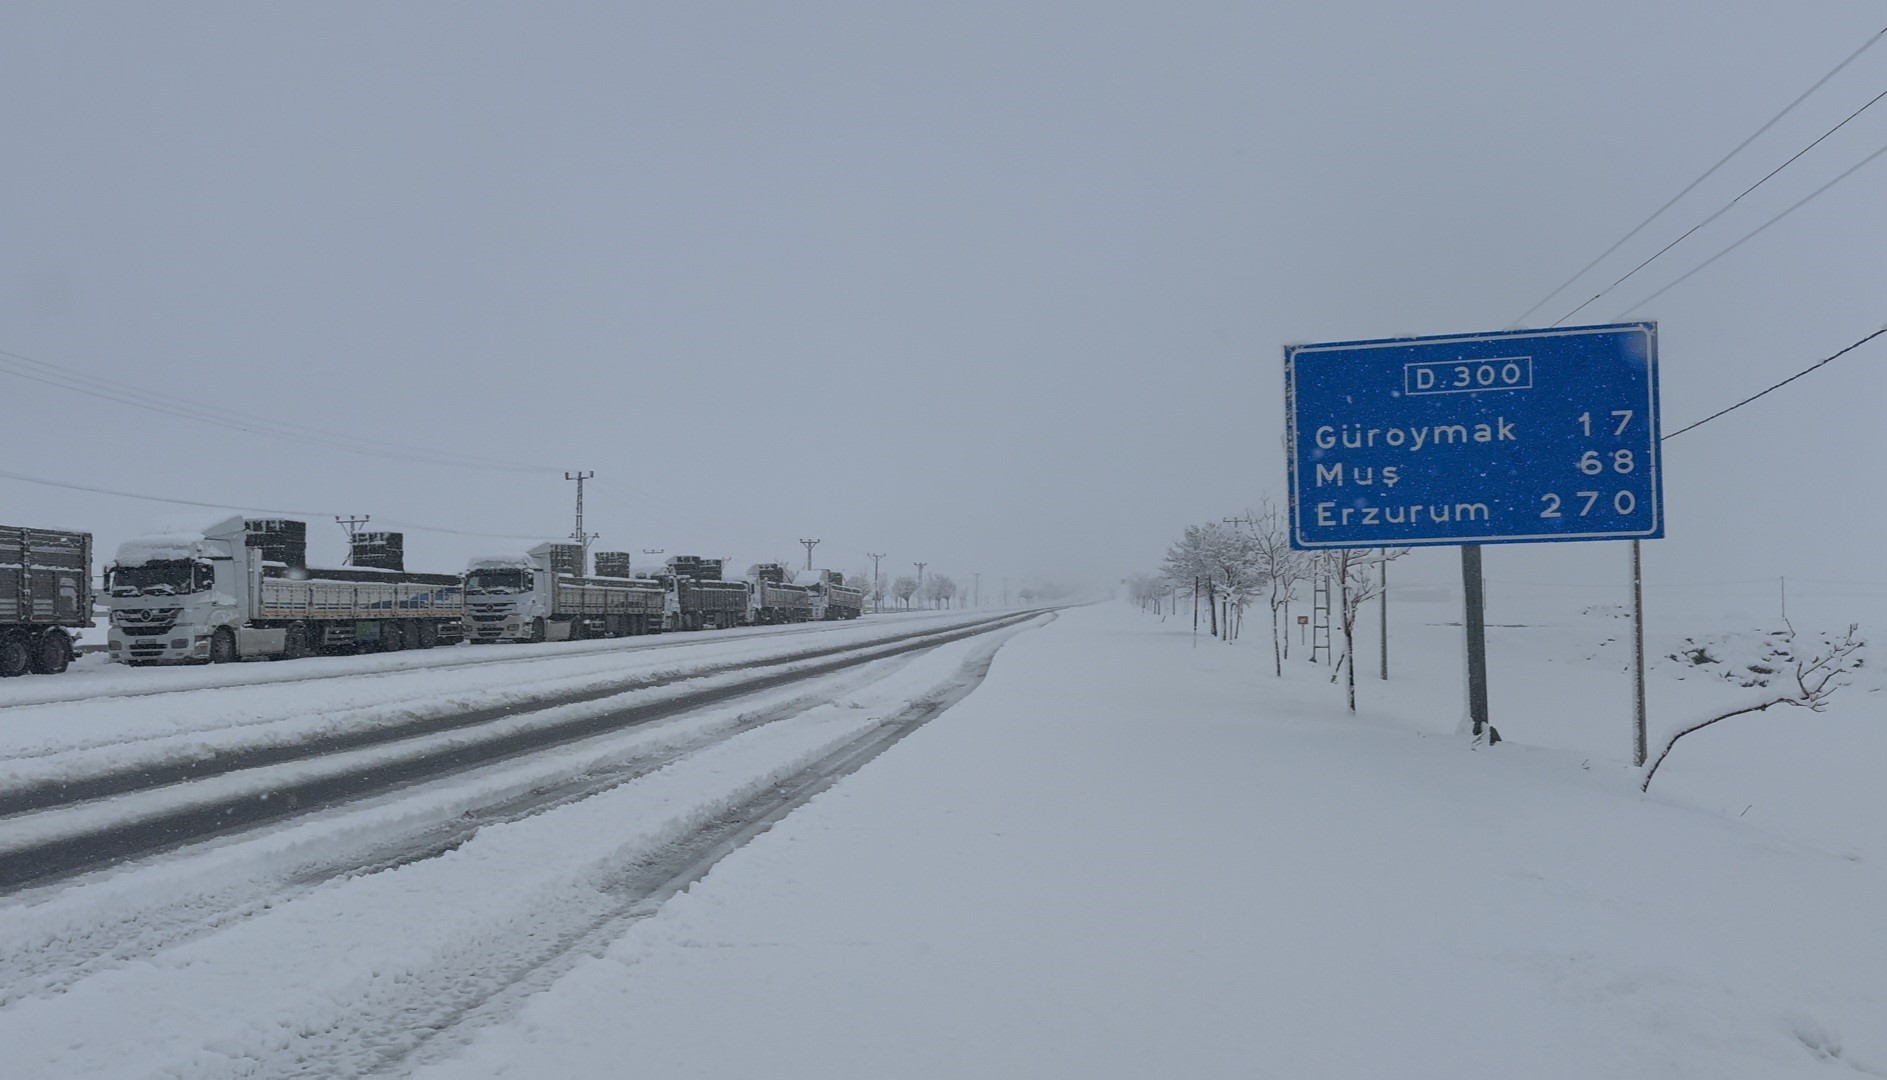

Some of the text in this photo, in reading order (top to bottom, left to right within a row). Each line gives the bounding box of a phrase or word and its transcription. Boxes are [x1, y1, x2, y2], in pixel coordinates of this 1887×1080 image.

[1453, 363, 1520, 387] 300
[1315, 409, 1633, 451] Güroymak 17
[1316, 450, 1635, 487] Muş 68
[1317, 491, 1636, 526] Erzurum 270
